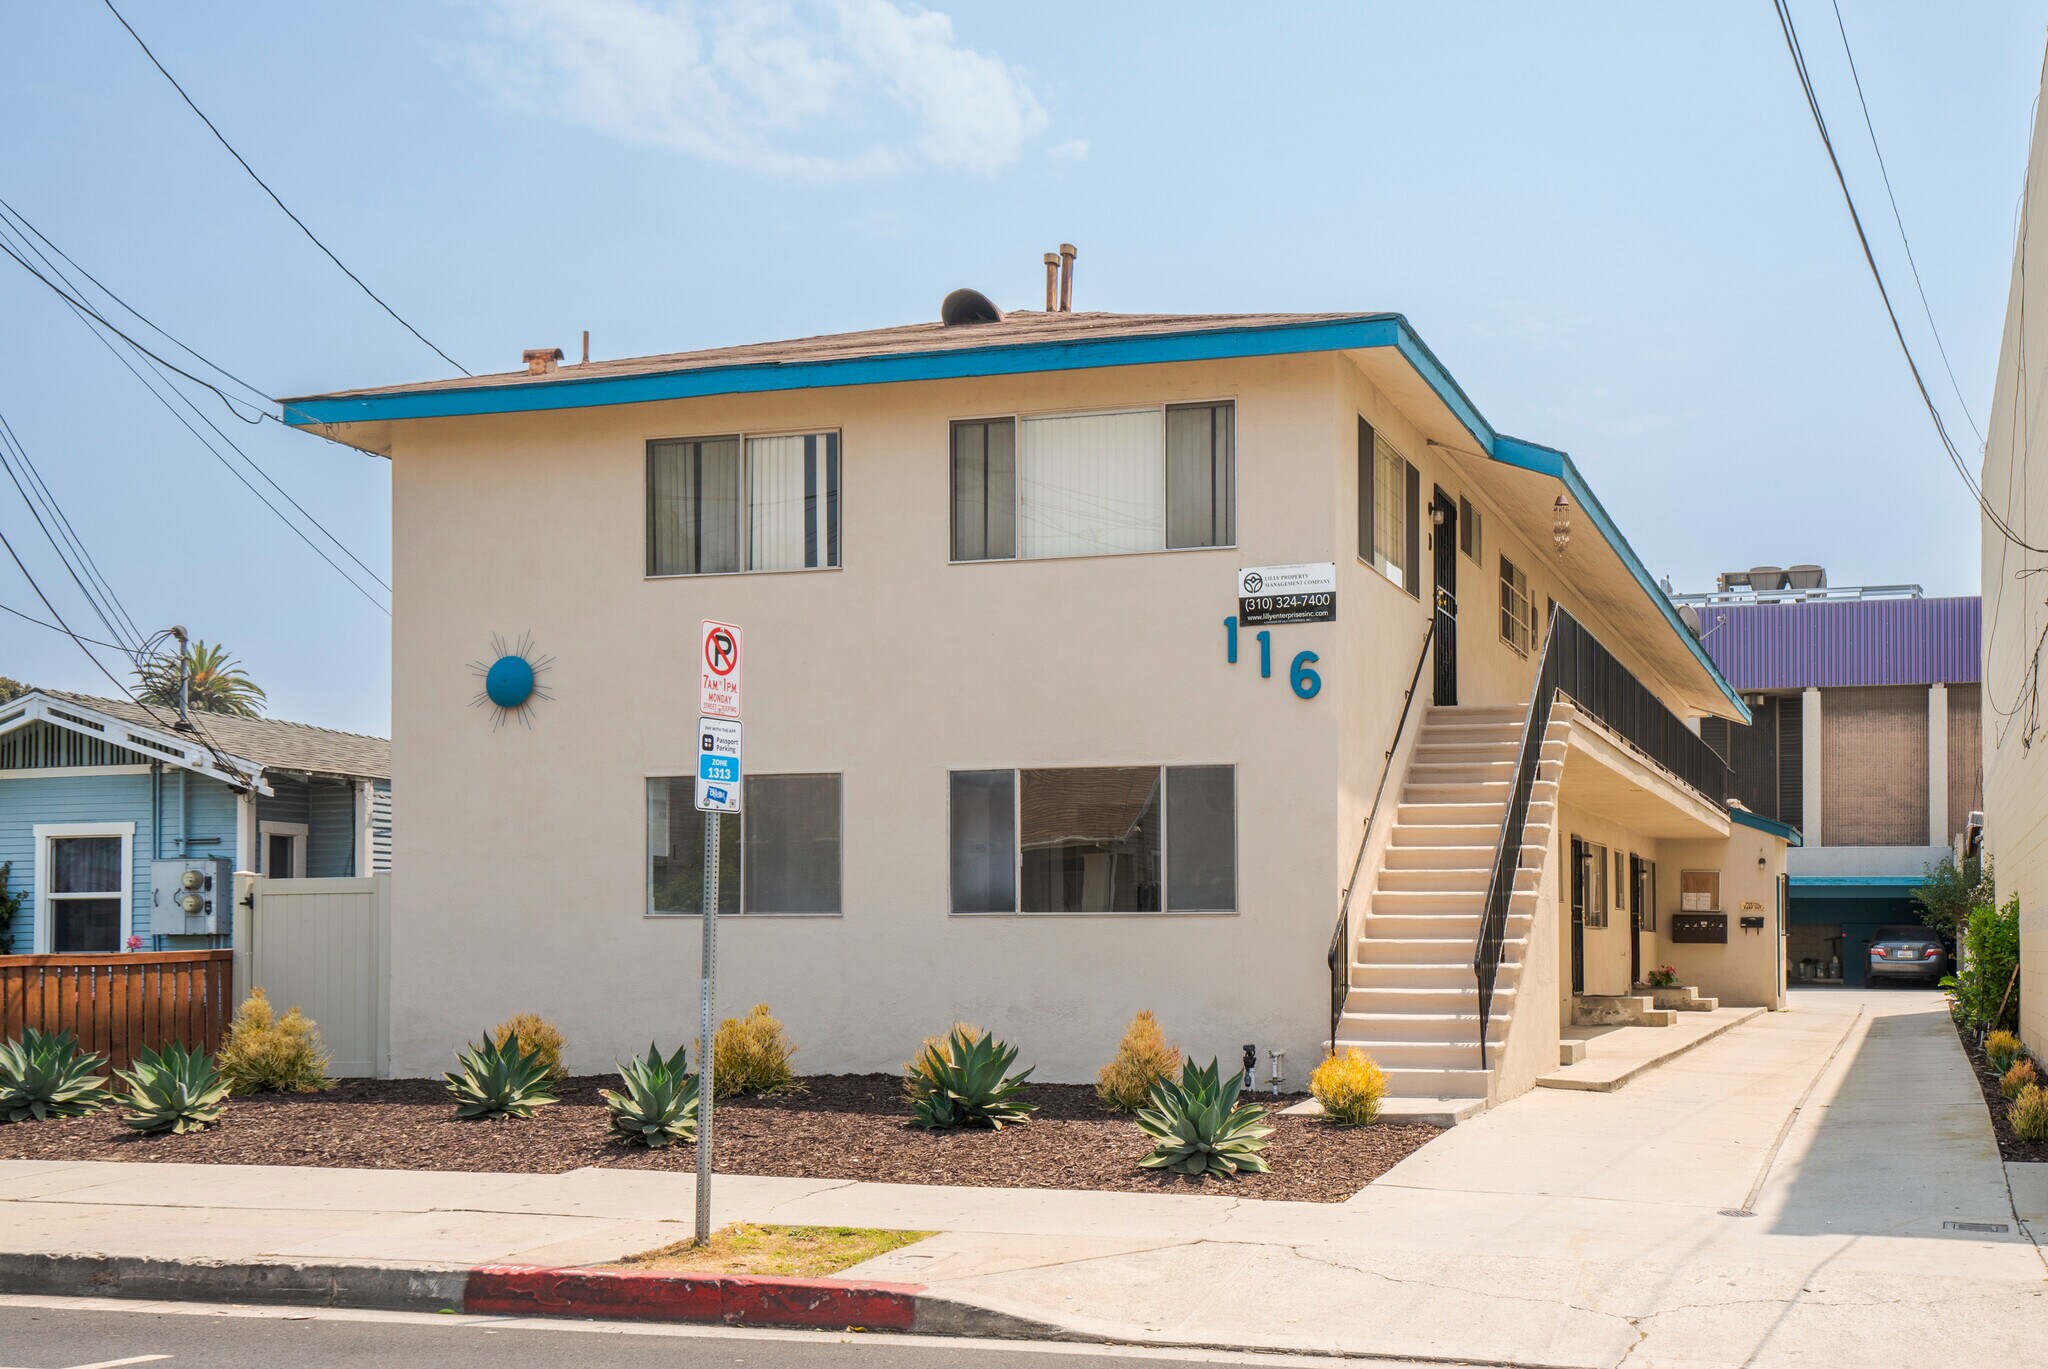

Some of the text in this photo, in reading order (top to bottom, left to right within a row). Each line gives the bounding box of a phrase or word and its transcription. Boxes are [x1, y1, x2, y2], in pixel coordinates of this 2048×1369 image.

[1245, 594, 1330, 612] (310) 324-7400
[1247, 610, 1329, 621] www.lillyenterprisesinc.com
[1224, 616, 1321, 699] 116
[708, 693, 732, 704] MONDAY
[716, 737, 738, 746] Passport
[716, 745, 736, 754] Parking
[711, 758, 728, 767] ZONE
[708, 767, 731, 780] 1313
